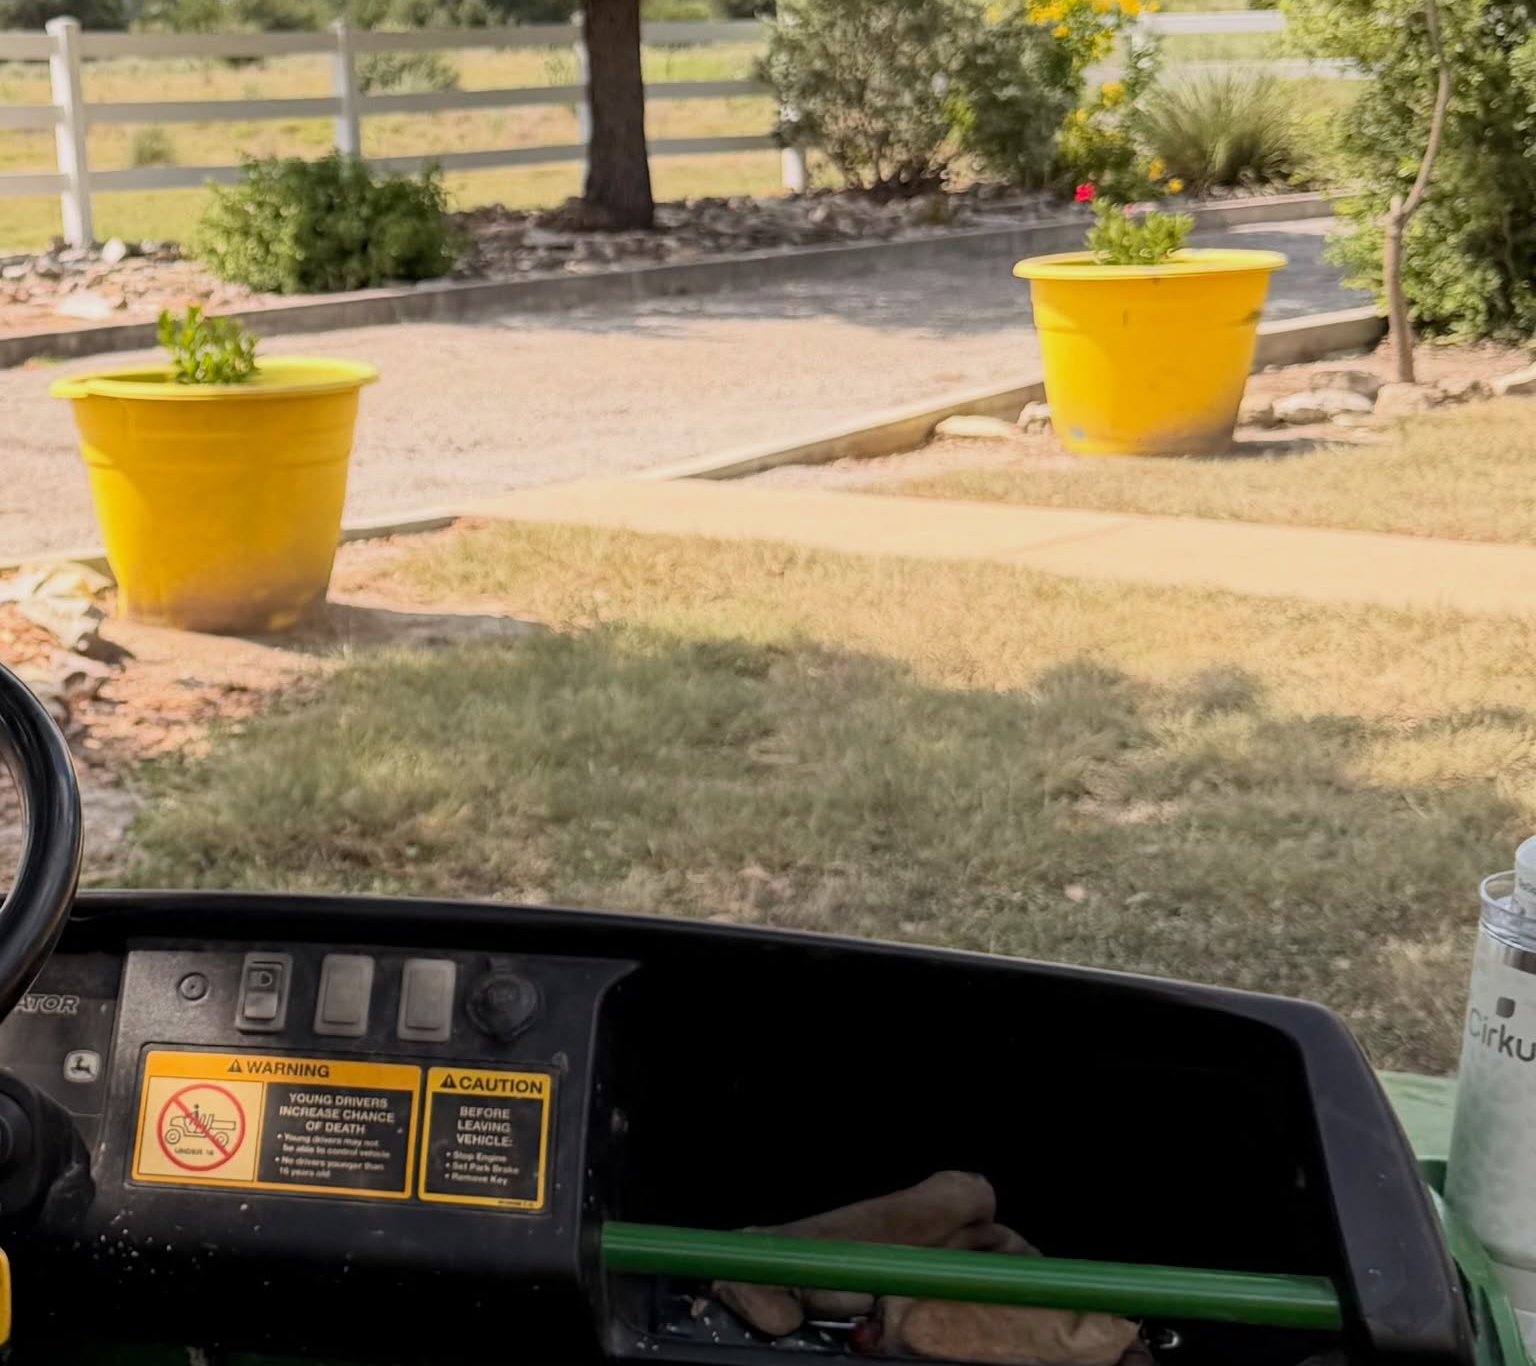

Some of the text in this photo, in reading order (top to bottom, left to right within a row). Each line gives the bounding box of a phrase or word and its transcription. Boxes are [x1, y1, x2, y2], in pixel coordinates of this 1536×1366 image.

[247, 1061, 330, 1078] WARNING
[458, 1075, 543, 1094] CAUTION
[289, 1093, 388, 1108] YOUNG DRIVERS
[279, 1106, 395, 1123] INCREASE CHANCE
[459, 1106, 511, 1119] BEFORE
[305, 1121, 365, 1134] OF DEATH
[457, 1119, 511, 1133] LEAVING
[456, 1133, 513, 1147] VEHICLE:
